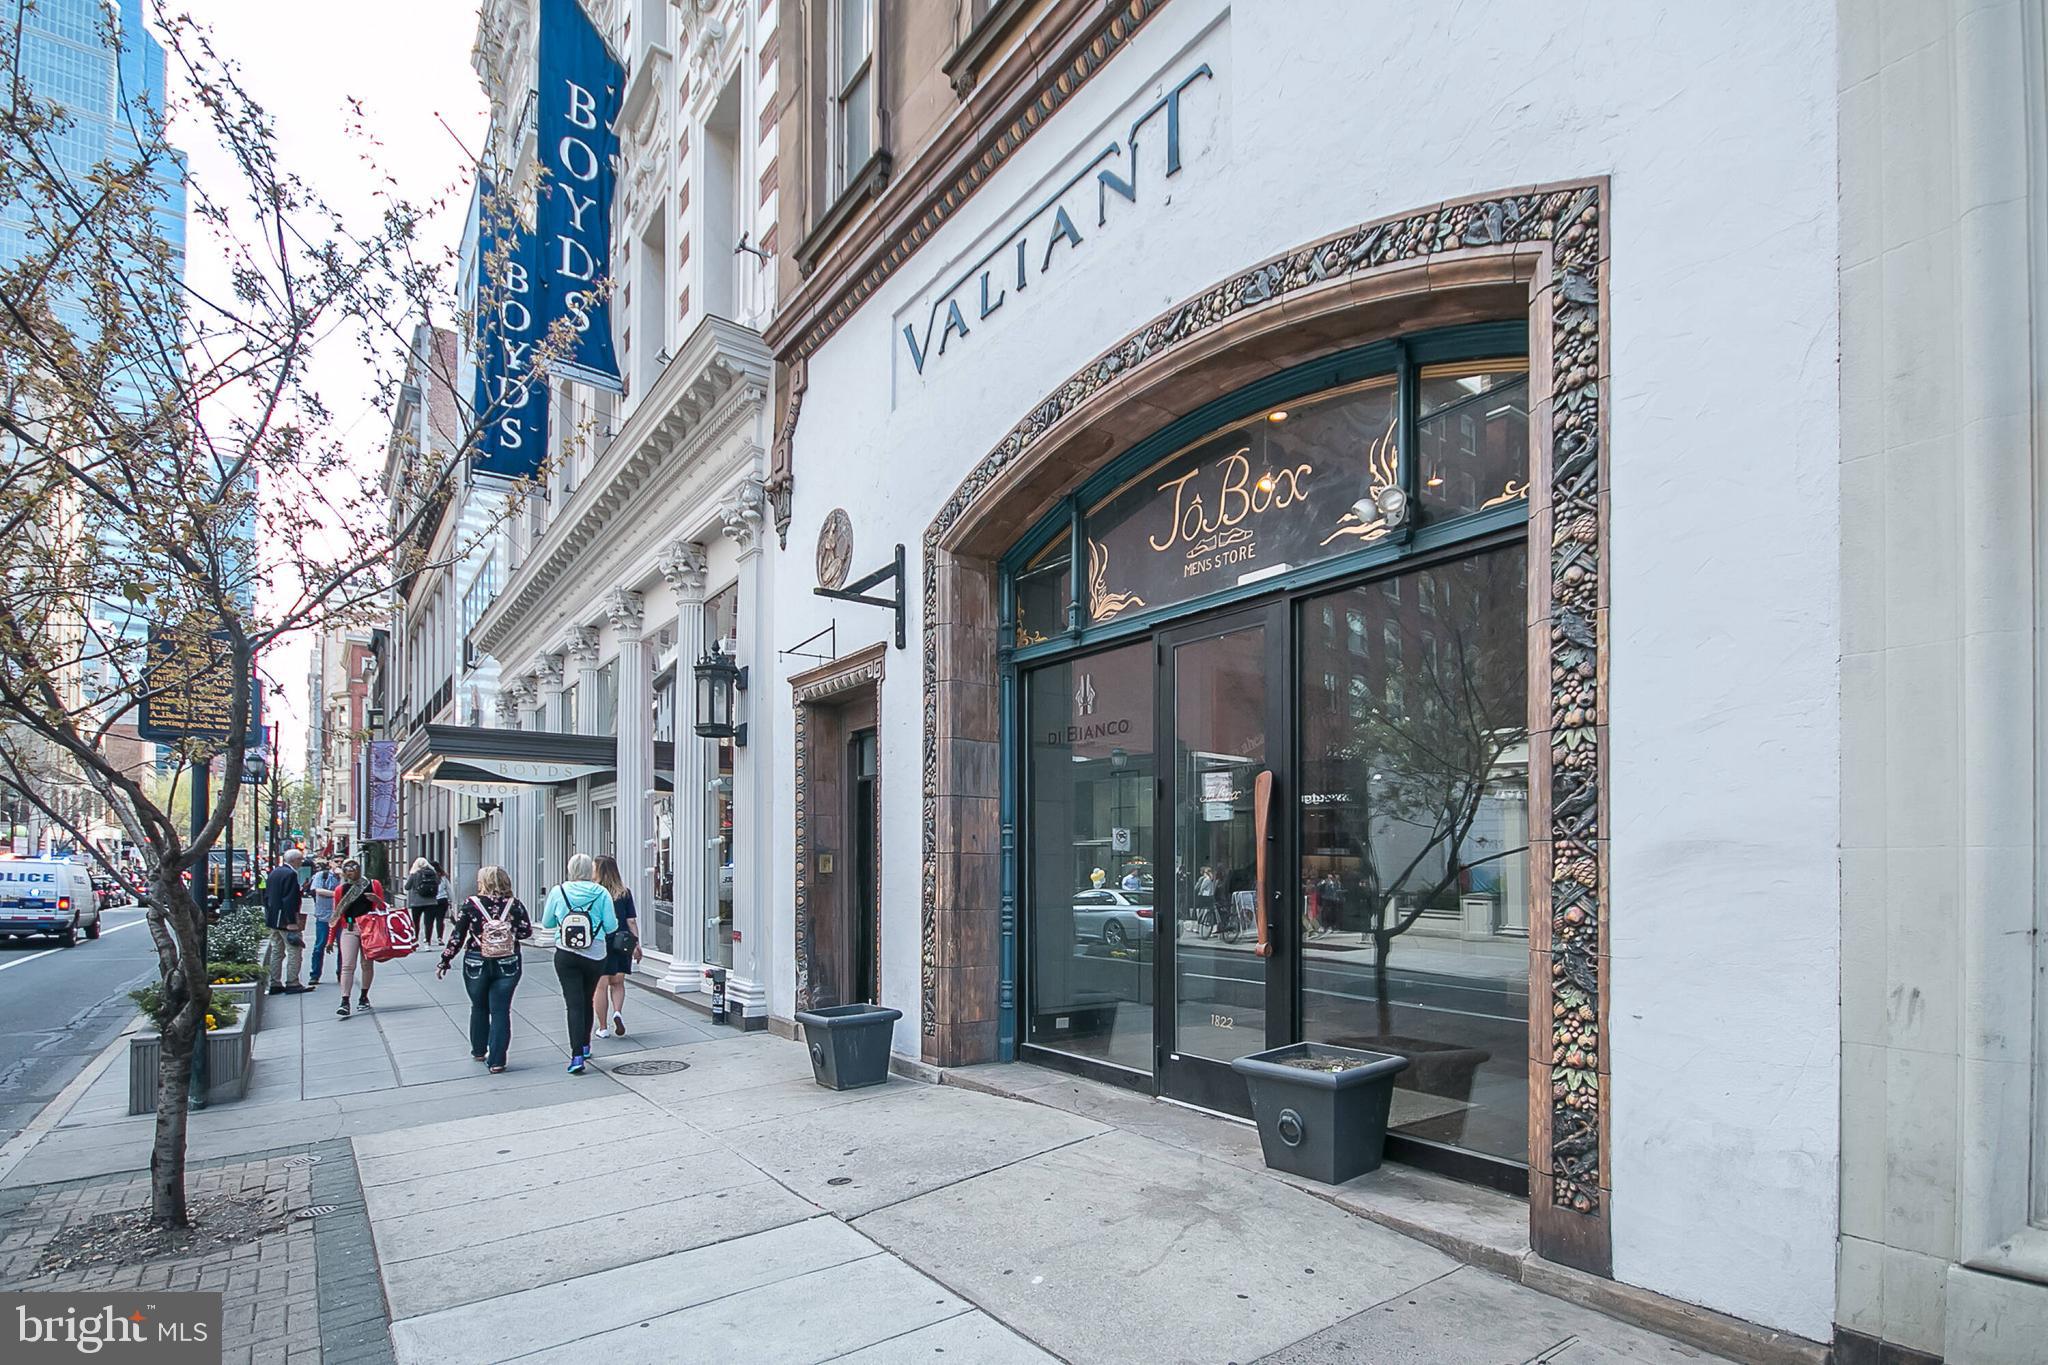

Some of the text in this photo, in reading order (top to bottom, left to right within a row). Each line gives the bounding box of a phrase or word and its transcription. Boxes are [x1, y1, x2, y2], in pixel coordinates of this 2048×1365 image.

[556, 79, 598, 333] BOYDS
[902, 62, 1213, 375] VALIANT
[495, 260, 531, 449] BOYDS
[1183, 542, 1256, 578] MENS STORE
[1047, 719, 1129, 745] DI BIANCO
[499, 763, 573, 777] BOYDS
[1211, 1014, 1234, 1030] 1822
